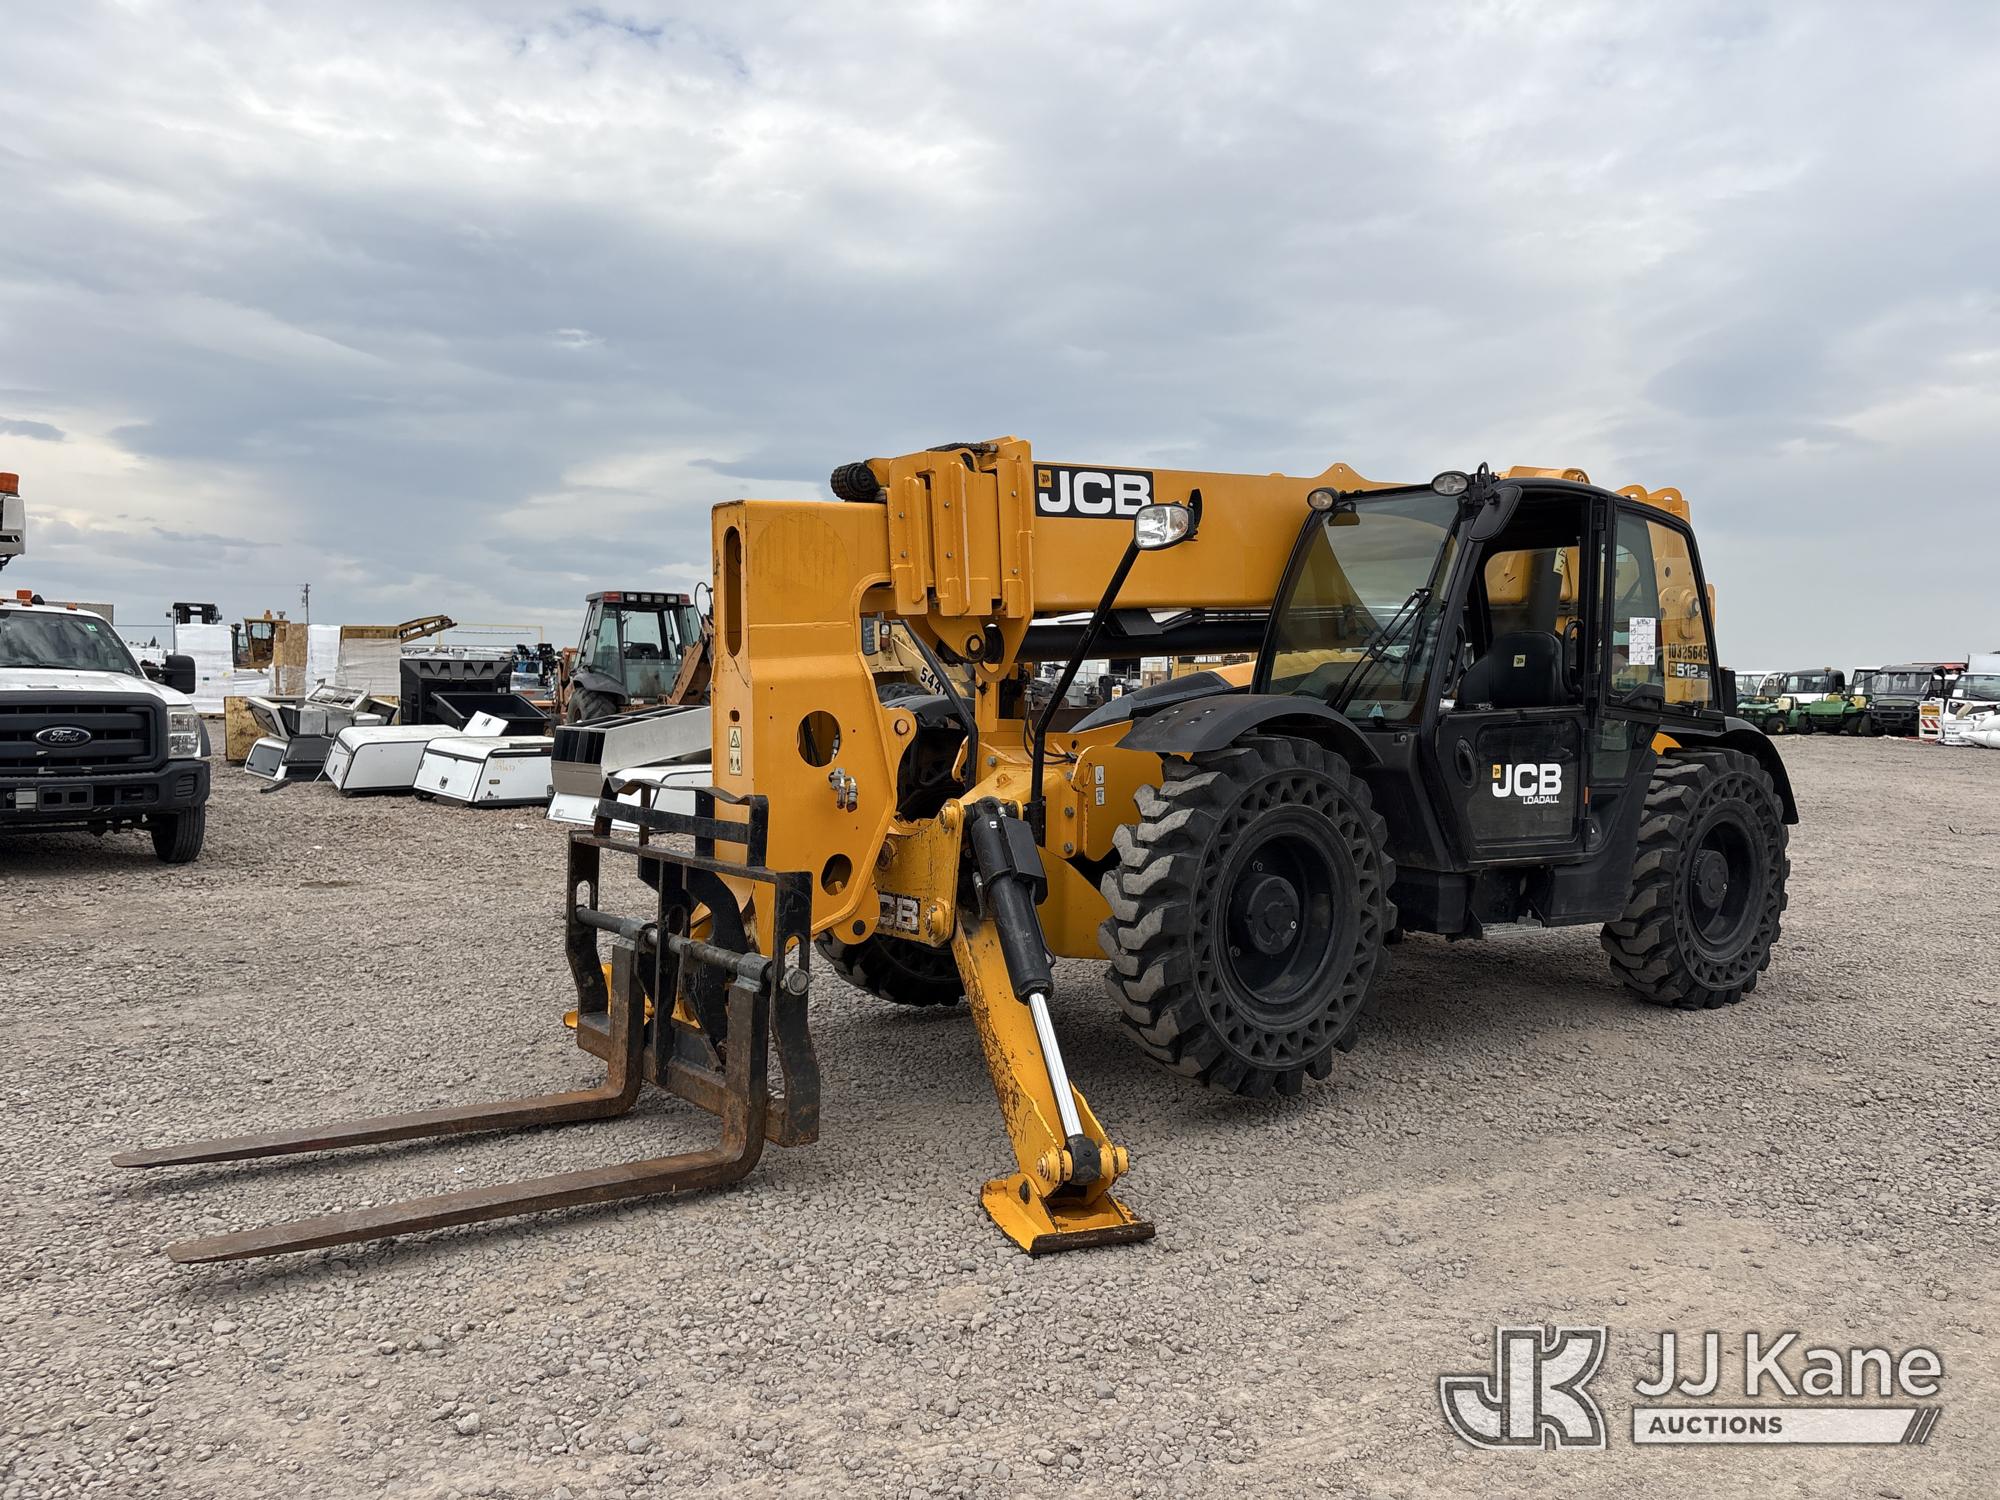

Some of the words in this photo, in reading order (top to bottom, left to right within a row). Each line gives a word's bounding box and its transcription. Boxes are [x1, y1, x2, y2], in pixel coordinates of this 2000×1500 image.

[1038, 471, 1152, 515] JCB
[920, 666, 946, 695] 544
[50, 730, 80, 742] Ford
[1492, 763, 1562, 797] JCB
[1523, 796, 1559, 805] LOADALL
[878, 894, 918, 930] CB
